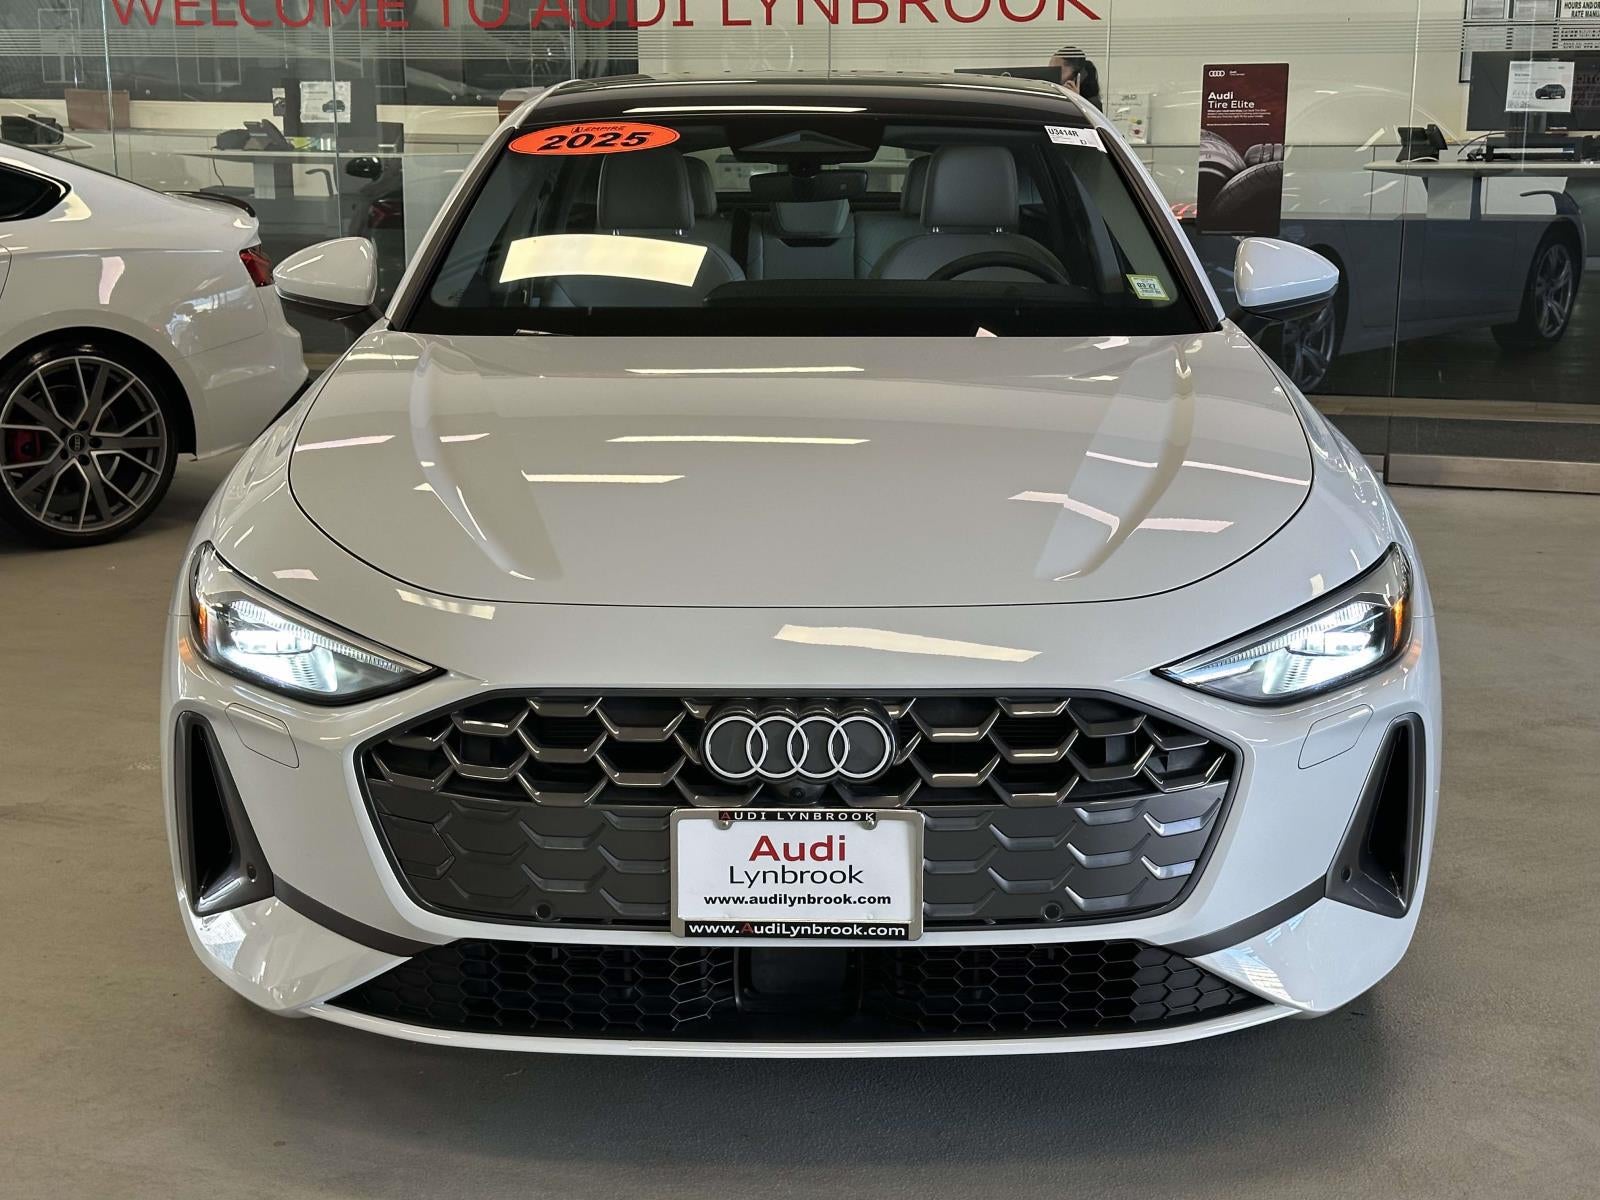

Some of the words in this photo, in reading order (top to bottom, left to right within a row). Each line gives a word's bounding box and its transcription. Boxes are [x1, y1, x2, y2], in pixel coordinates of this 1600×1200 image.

[1564, 1, 1581, 9] HOURS
[1207, 91, 1234, 100] Audi
[1207, 100, 1228, 109] Tire
[1230, 100, 1255, 109] Elite
[1047, 128, 1079, 137] U3414R
[537, 132, 653, 151] 2025
[720, 811, 768, 821] AUDI
[777, 811, 876, 821] LYNBROOK
[748, 834, 846, 862] Audi
[729, 864, 865, 889] Lynbrook
[703, 893, 892, 907] www.audilynbrook.com
[688, 921, 906, 937] www.AudiLynbrook.com
